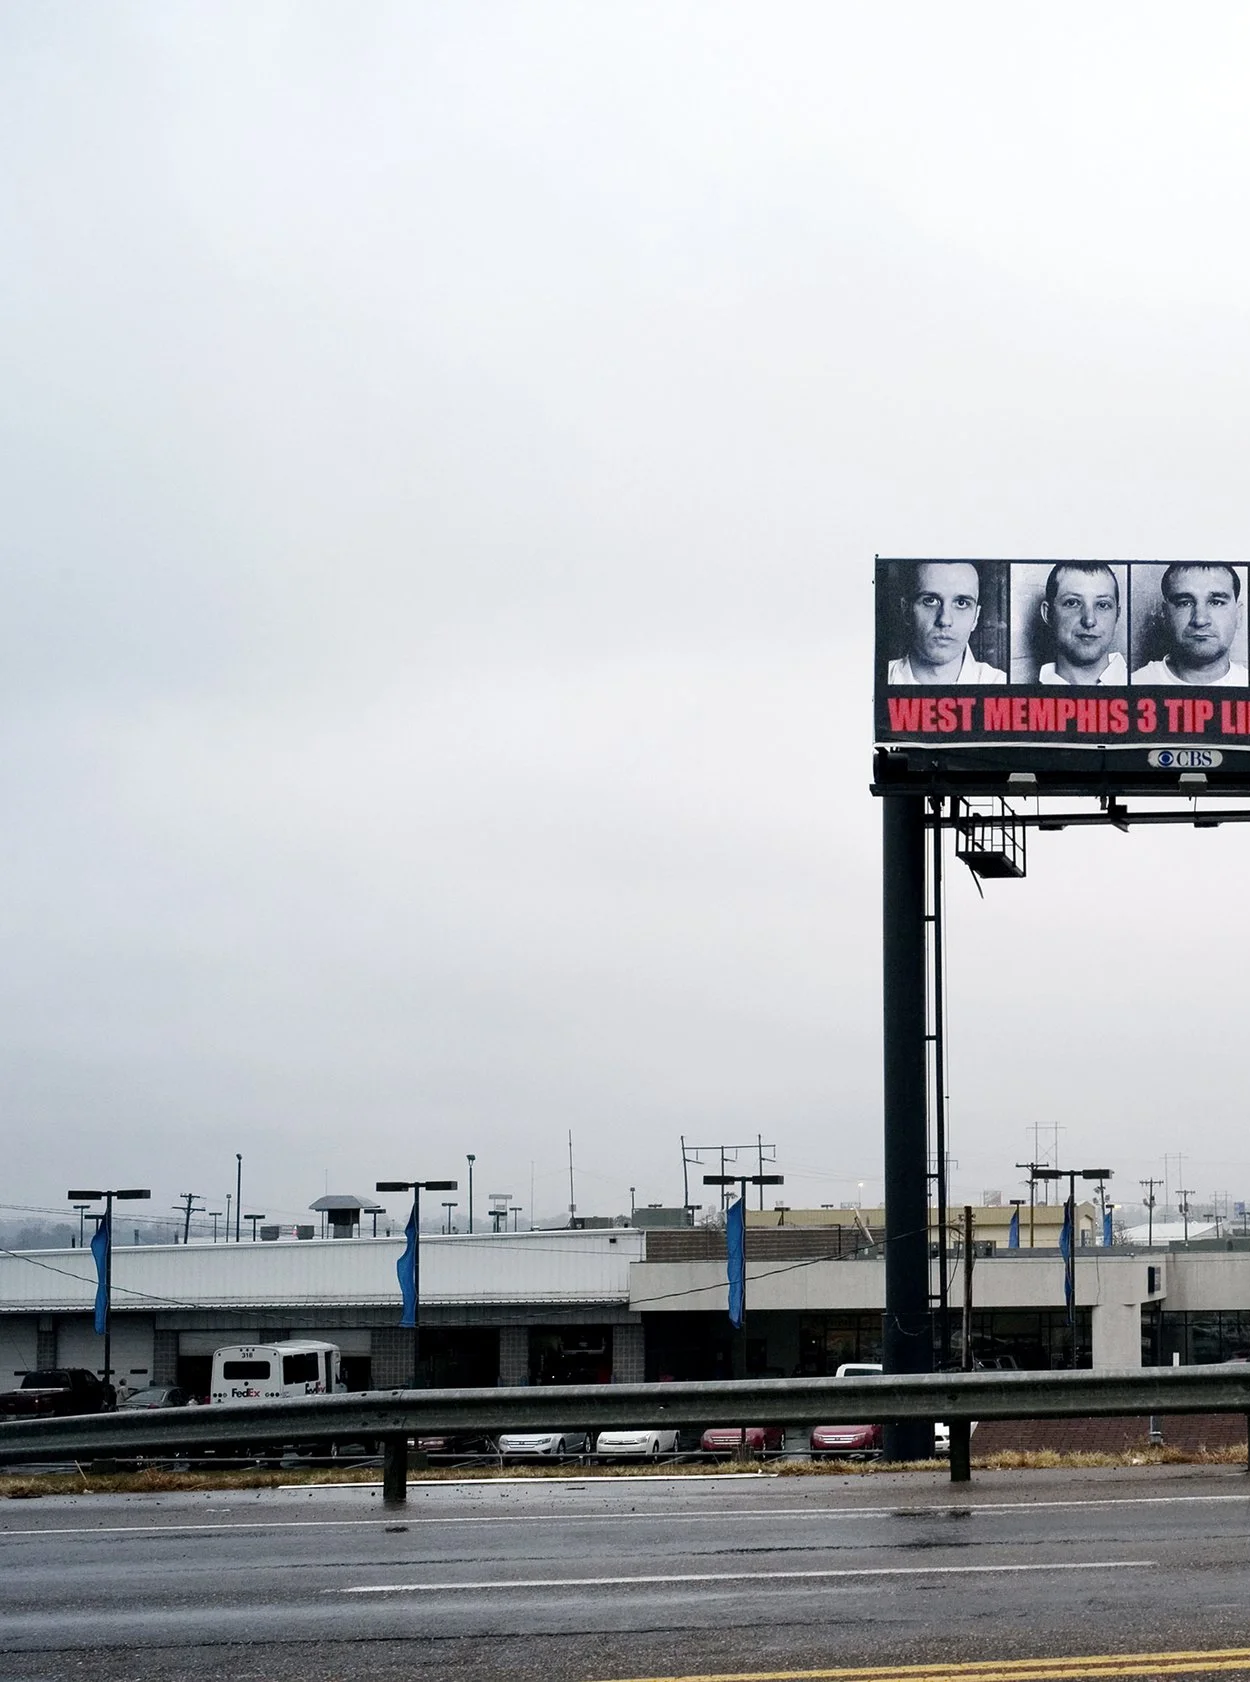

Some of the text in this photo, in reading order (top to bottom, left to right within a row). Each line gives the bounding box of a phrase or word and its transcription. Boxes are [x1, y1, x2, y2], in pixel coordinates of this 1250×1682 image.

[888, 697, 975, 732] WEST
[983, 697, 1129, 733] MEMPHIS
[1137, 698, 1157, 733] 3
[1164, 699, 1214, 733] TIP
[1177, 750, 1212, 767] CBS
[231, 1387, 260, 1398] FedEx
